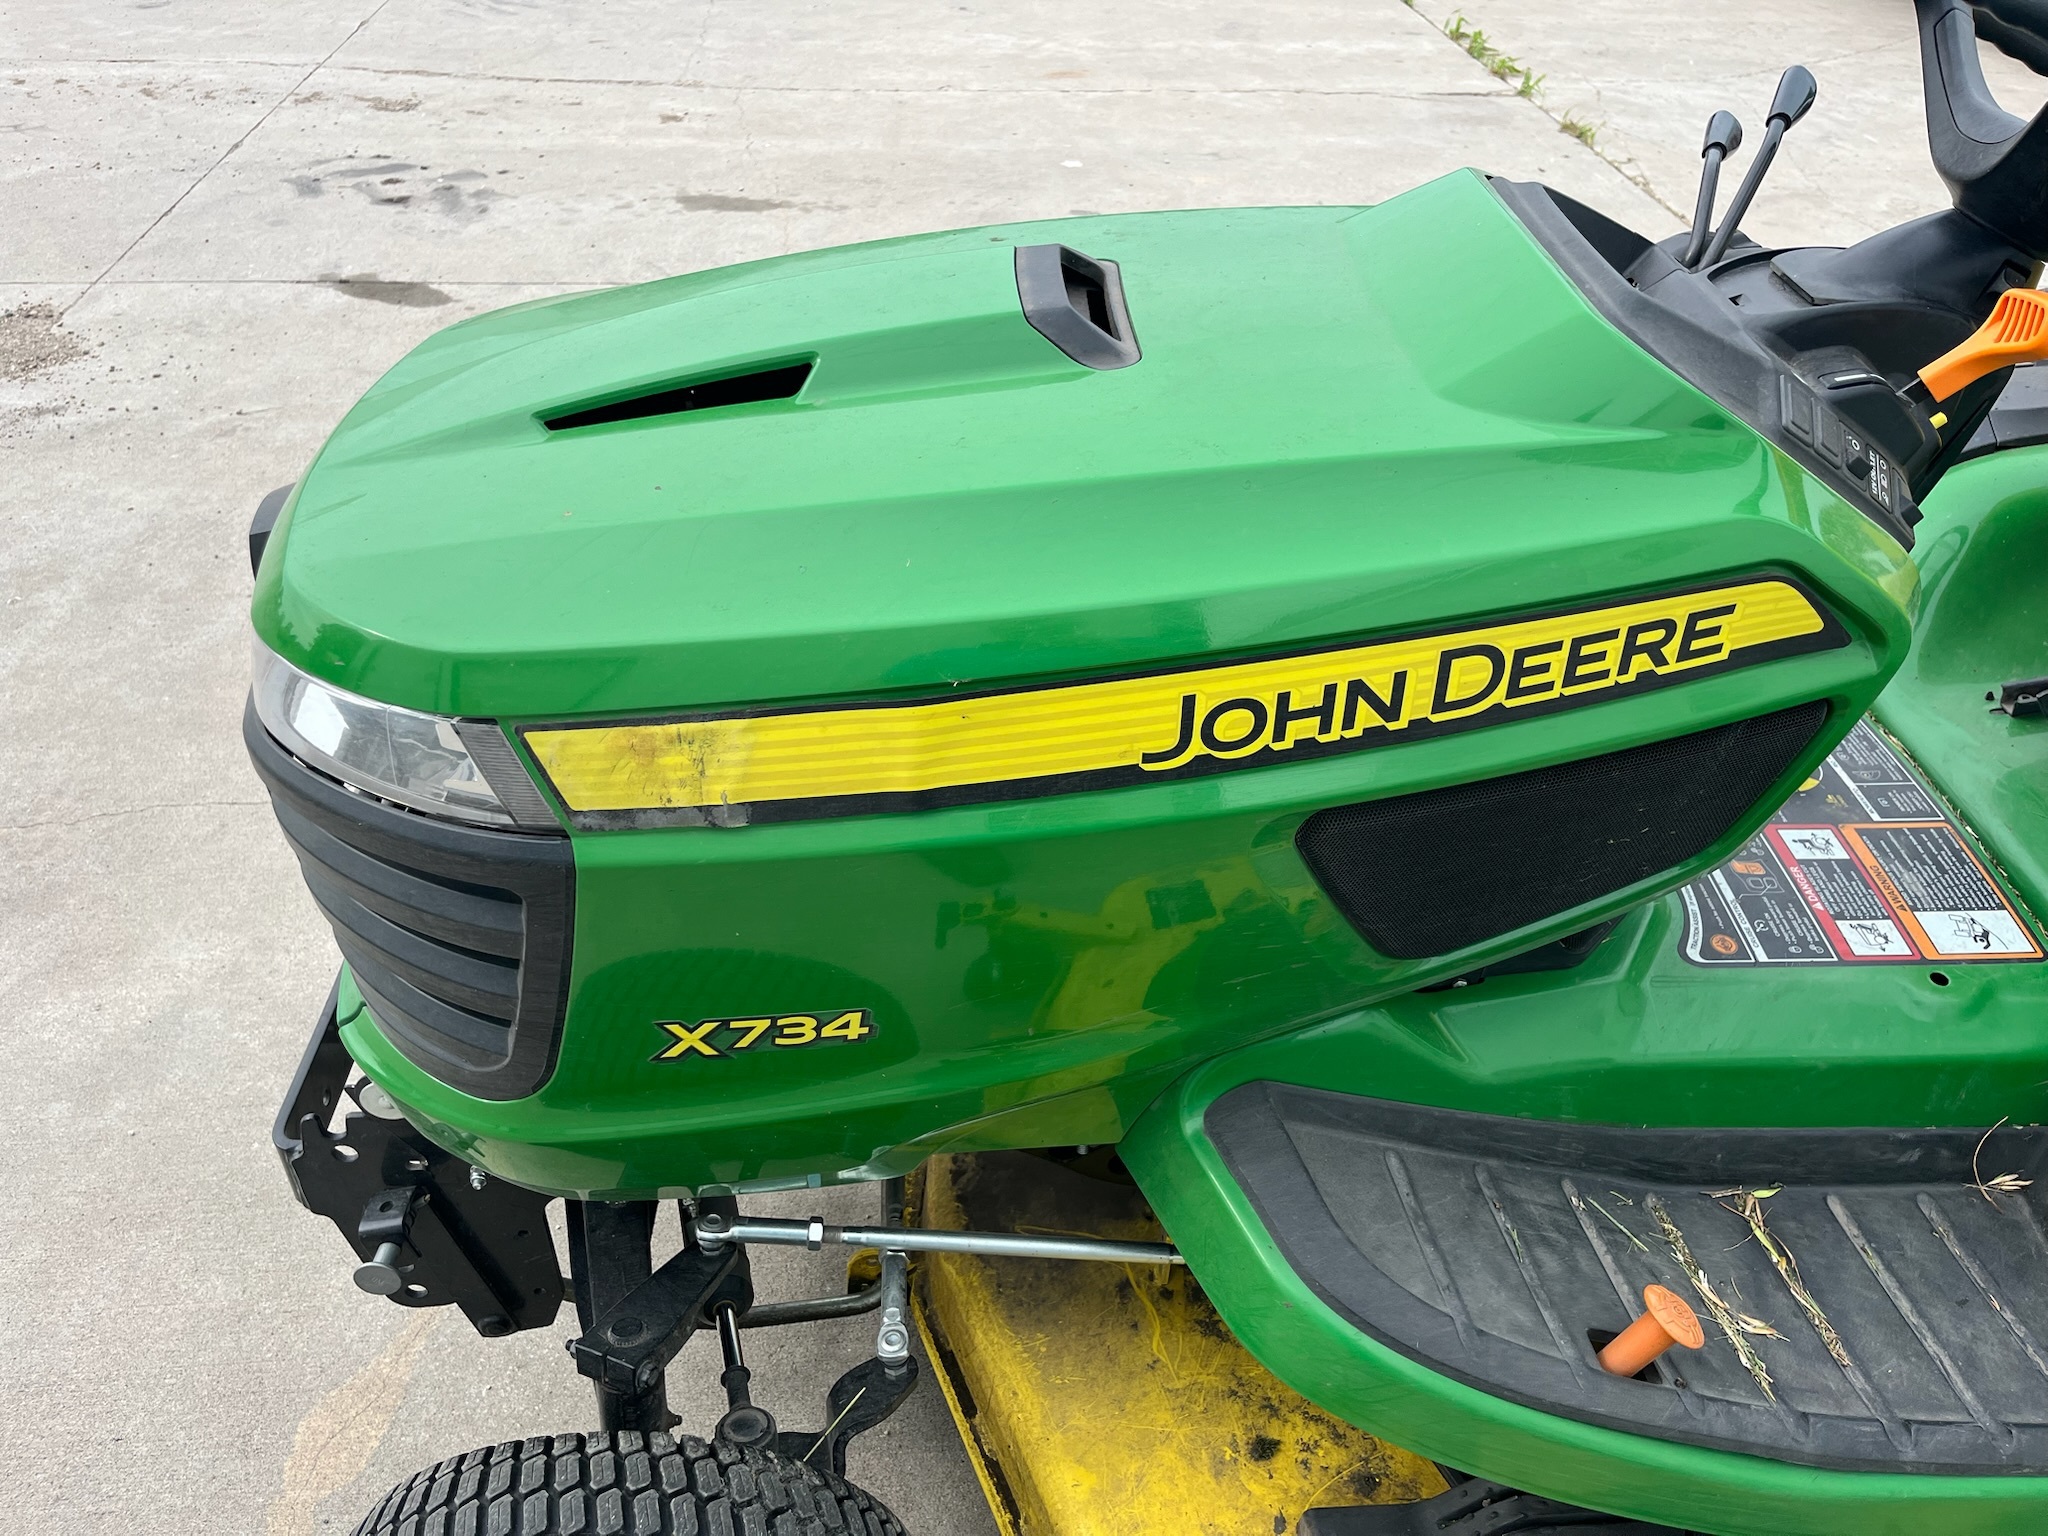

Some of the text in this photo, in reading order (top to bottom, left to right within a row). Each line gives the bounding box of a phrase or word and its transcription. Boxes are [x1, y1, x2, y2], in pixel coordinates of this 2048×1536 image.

[1140, 603, 1738, 767] JOHN DEERE
[1791, 866, 1818, 902] DANGER
[1870, 865, 1902, 903] WARNING
[1690, 909, 1699, 926] ASSIST
[1690, 924, 1700, 950] TRACTION
[650, 1010, 874, 1060] X734
